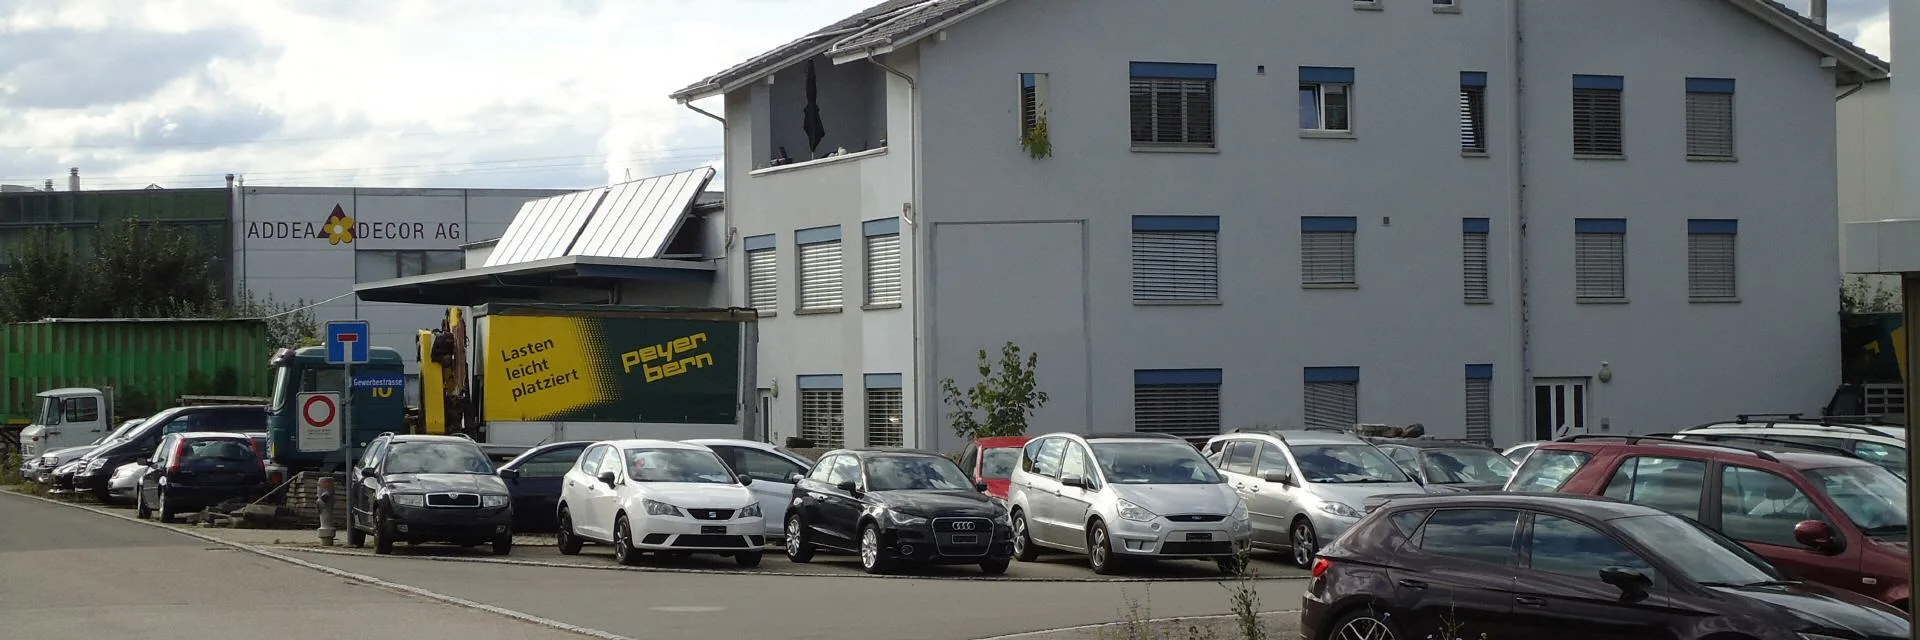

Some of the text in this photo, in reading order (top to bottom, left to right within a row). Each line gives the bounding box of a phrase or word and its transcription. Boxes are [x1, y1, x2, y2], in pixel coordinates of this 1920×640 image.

[247, 221, 460, 240] ADDEA DECOR AG
[501, 337, 554, 363] Lasten
[621, 332, 707, 374] peyer
[505, 357, 550, 381] leicht
[643, 352, 713, 383] bern
[353, 378, 403, 386] Gewerbestrasse
[511, 368, 579, 402] platziert
